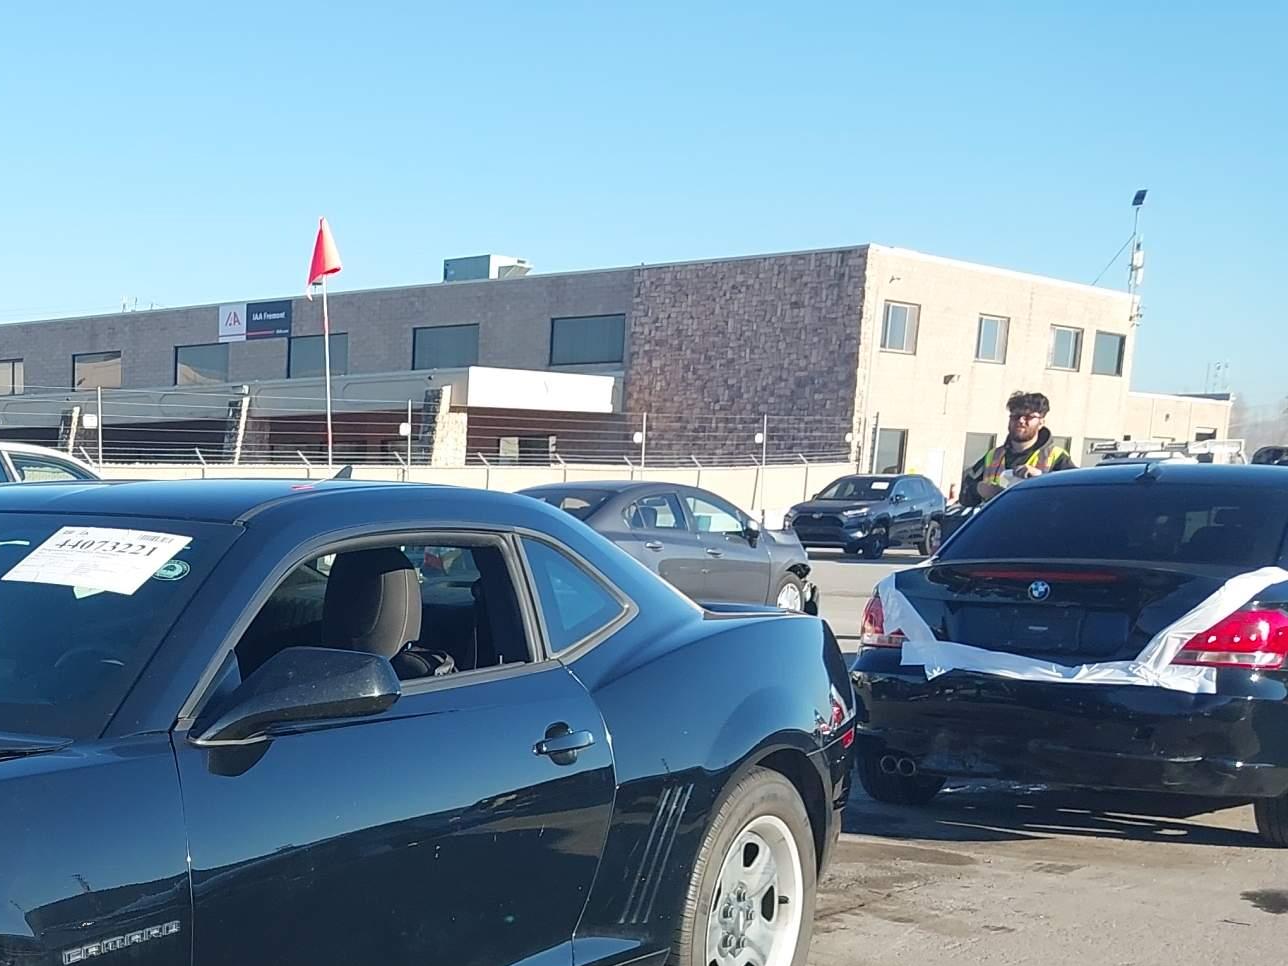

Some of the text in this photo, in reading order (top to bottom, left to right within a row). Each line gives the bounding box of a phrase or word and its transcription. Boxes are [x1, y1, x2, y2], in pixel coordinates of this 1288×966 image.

[252, 311, 286, 321] IAA Fremont
[55, 538, 158, 556] 44073221
[62, 920, 181, 965] CAMARO
